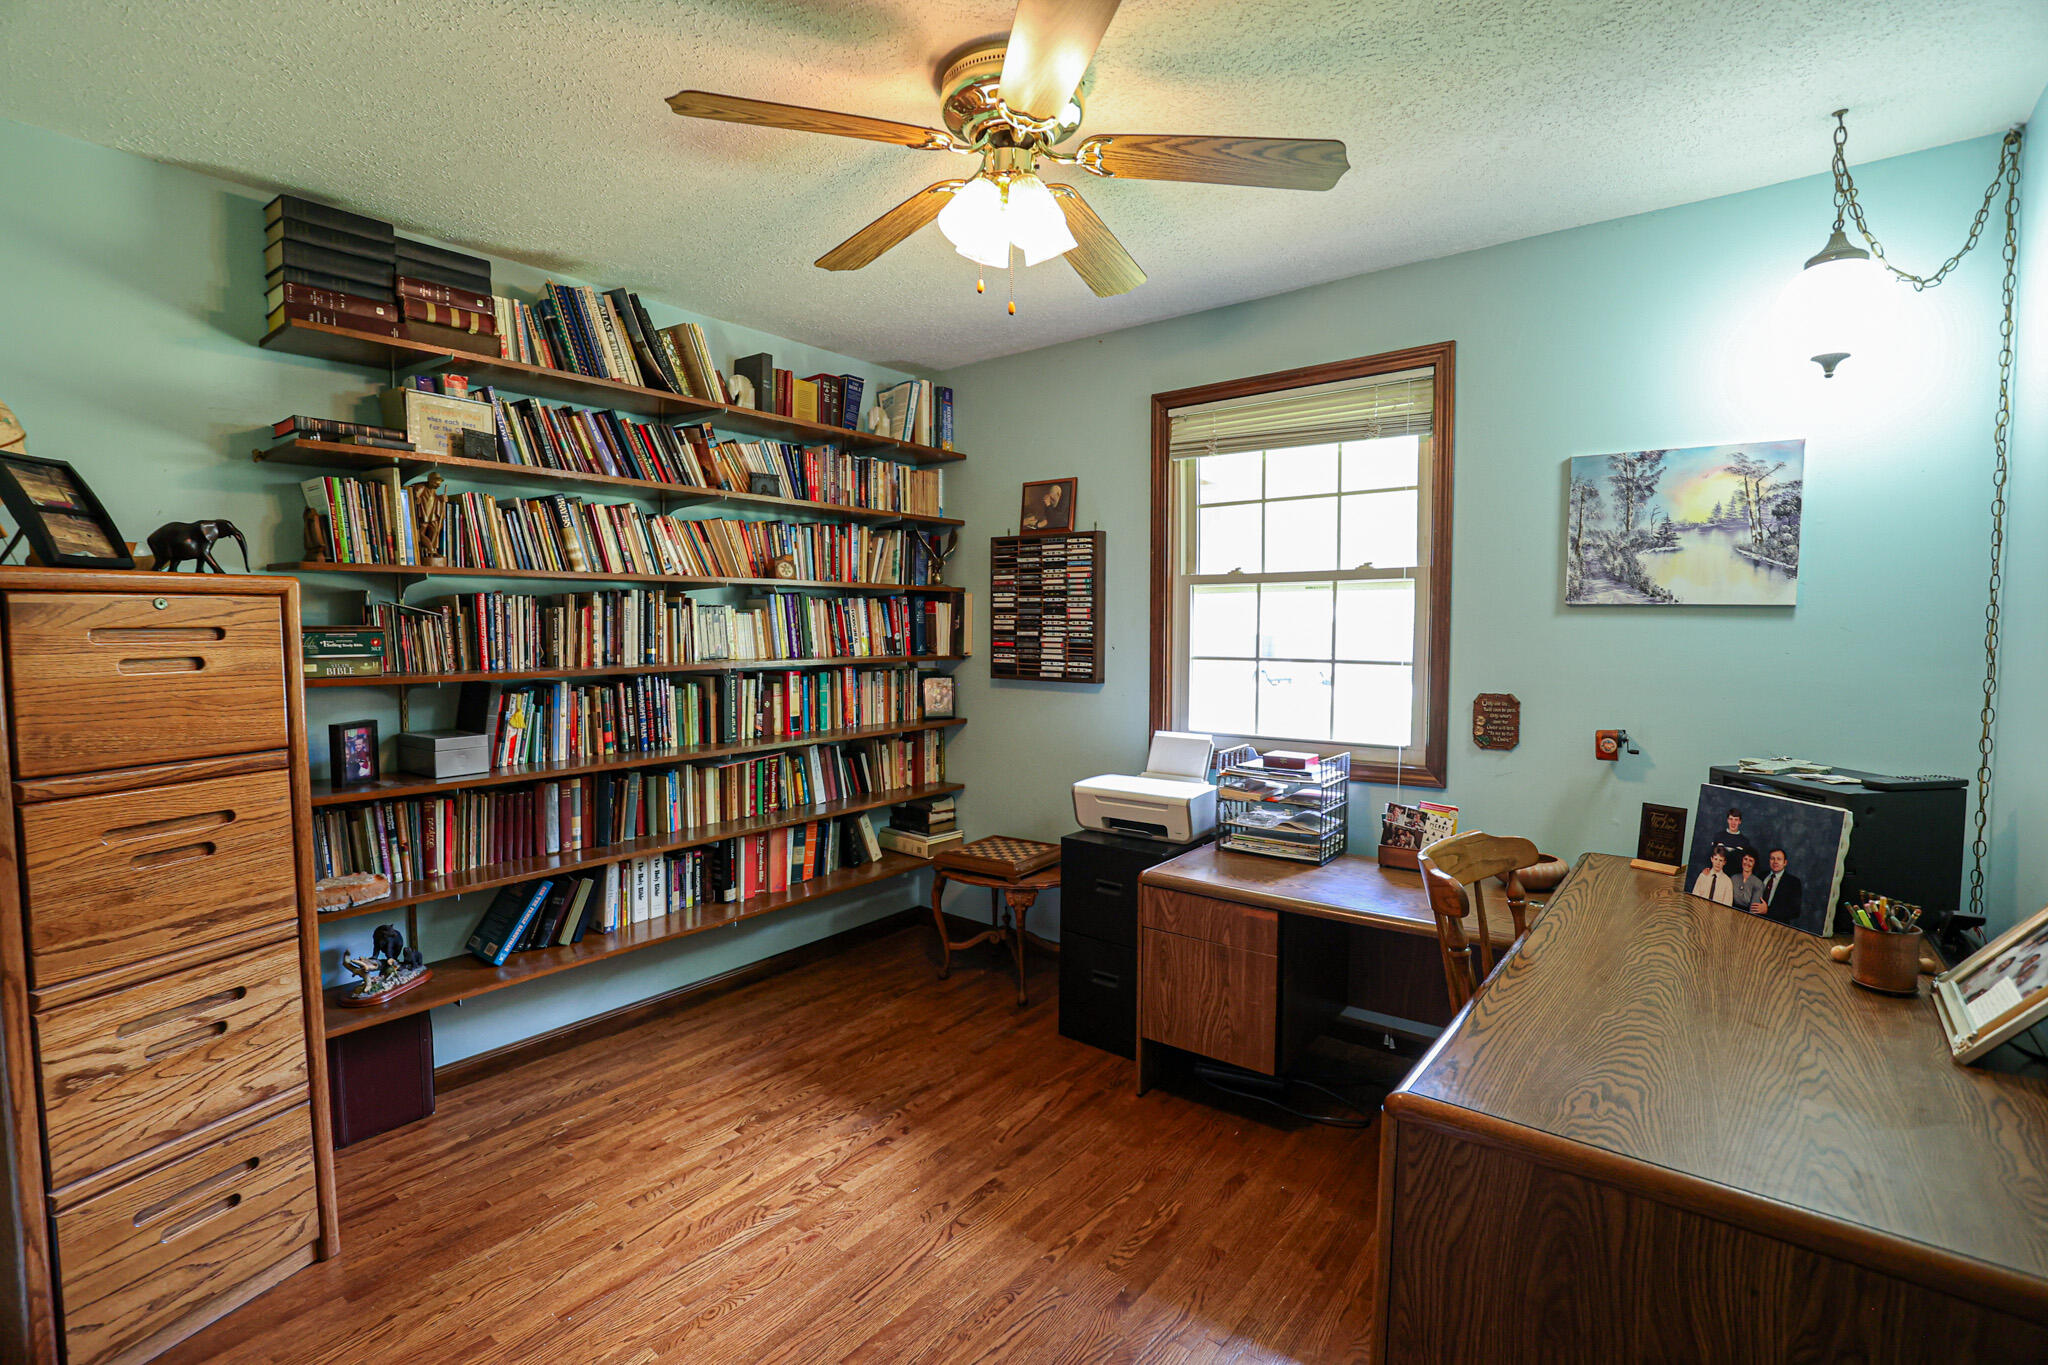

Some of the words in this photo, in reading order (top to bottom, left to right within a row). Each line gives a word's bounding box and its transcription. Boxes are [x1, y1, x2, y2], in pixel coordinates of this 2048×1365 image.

[599, 305, 612, 332] ATLAS
[848, 384, 861, 392] BIBLE
[557, 498, 572, 528] PRAYERS
[326, 667, 355, 676] BIBLE
[637, 686, 646, 719] STRAIGHT
[640, 722, 648, 739] TALK
[1429, 822, 1449, 832] MERRY
[636, 874, 644, 886] Holy
[538, 886, 547, 895] ASK
[532, 896, 541, 907] THE
[521, 907, 535, 925] FAMILY
[504, 924, 524, 952] HANDYMAN
